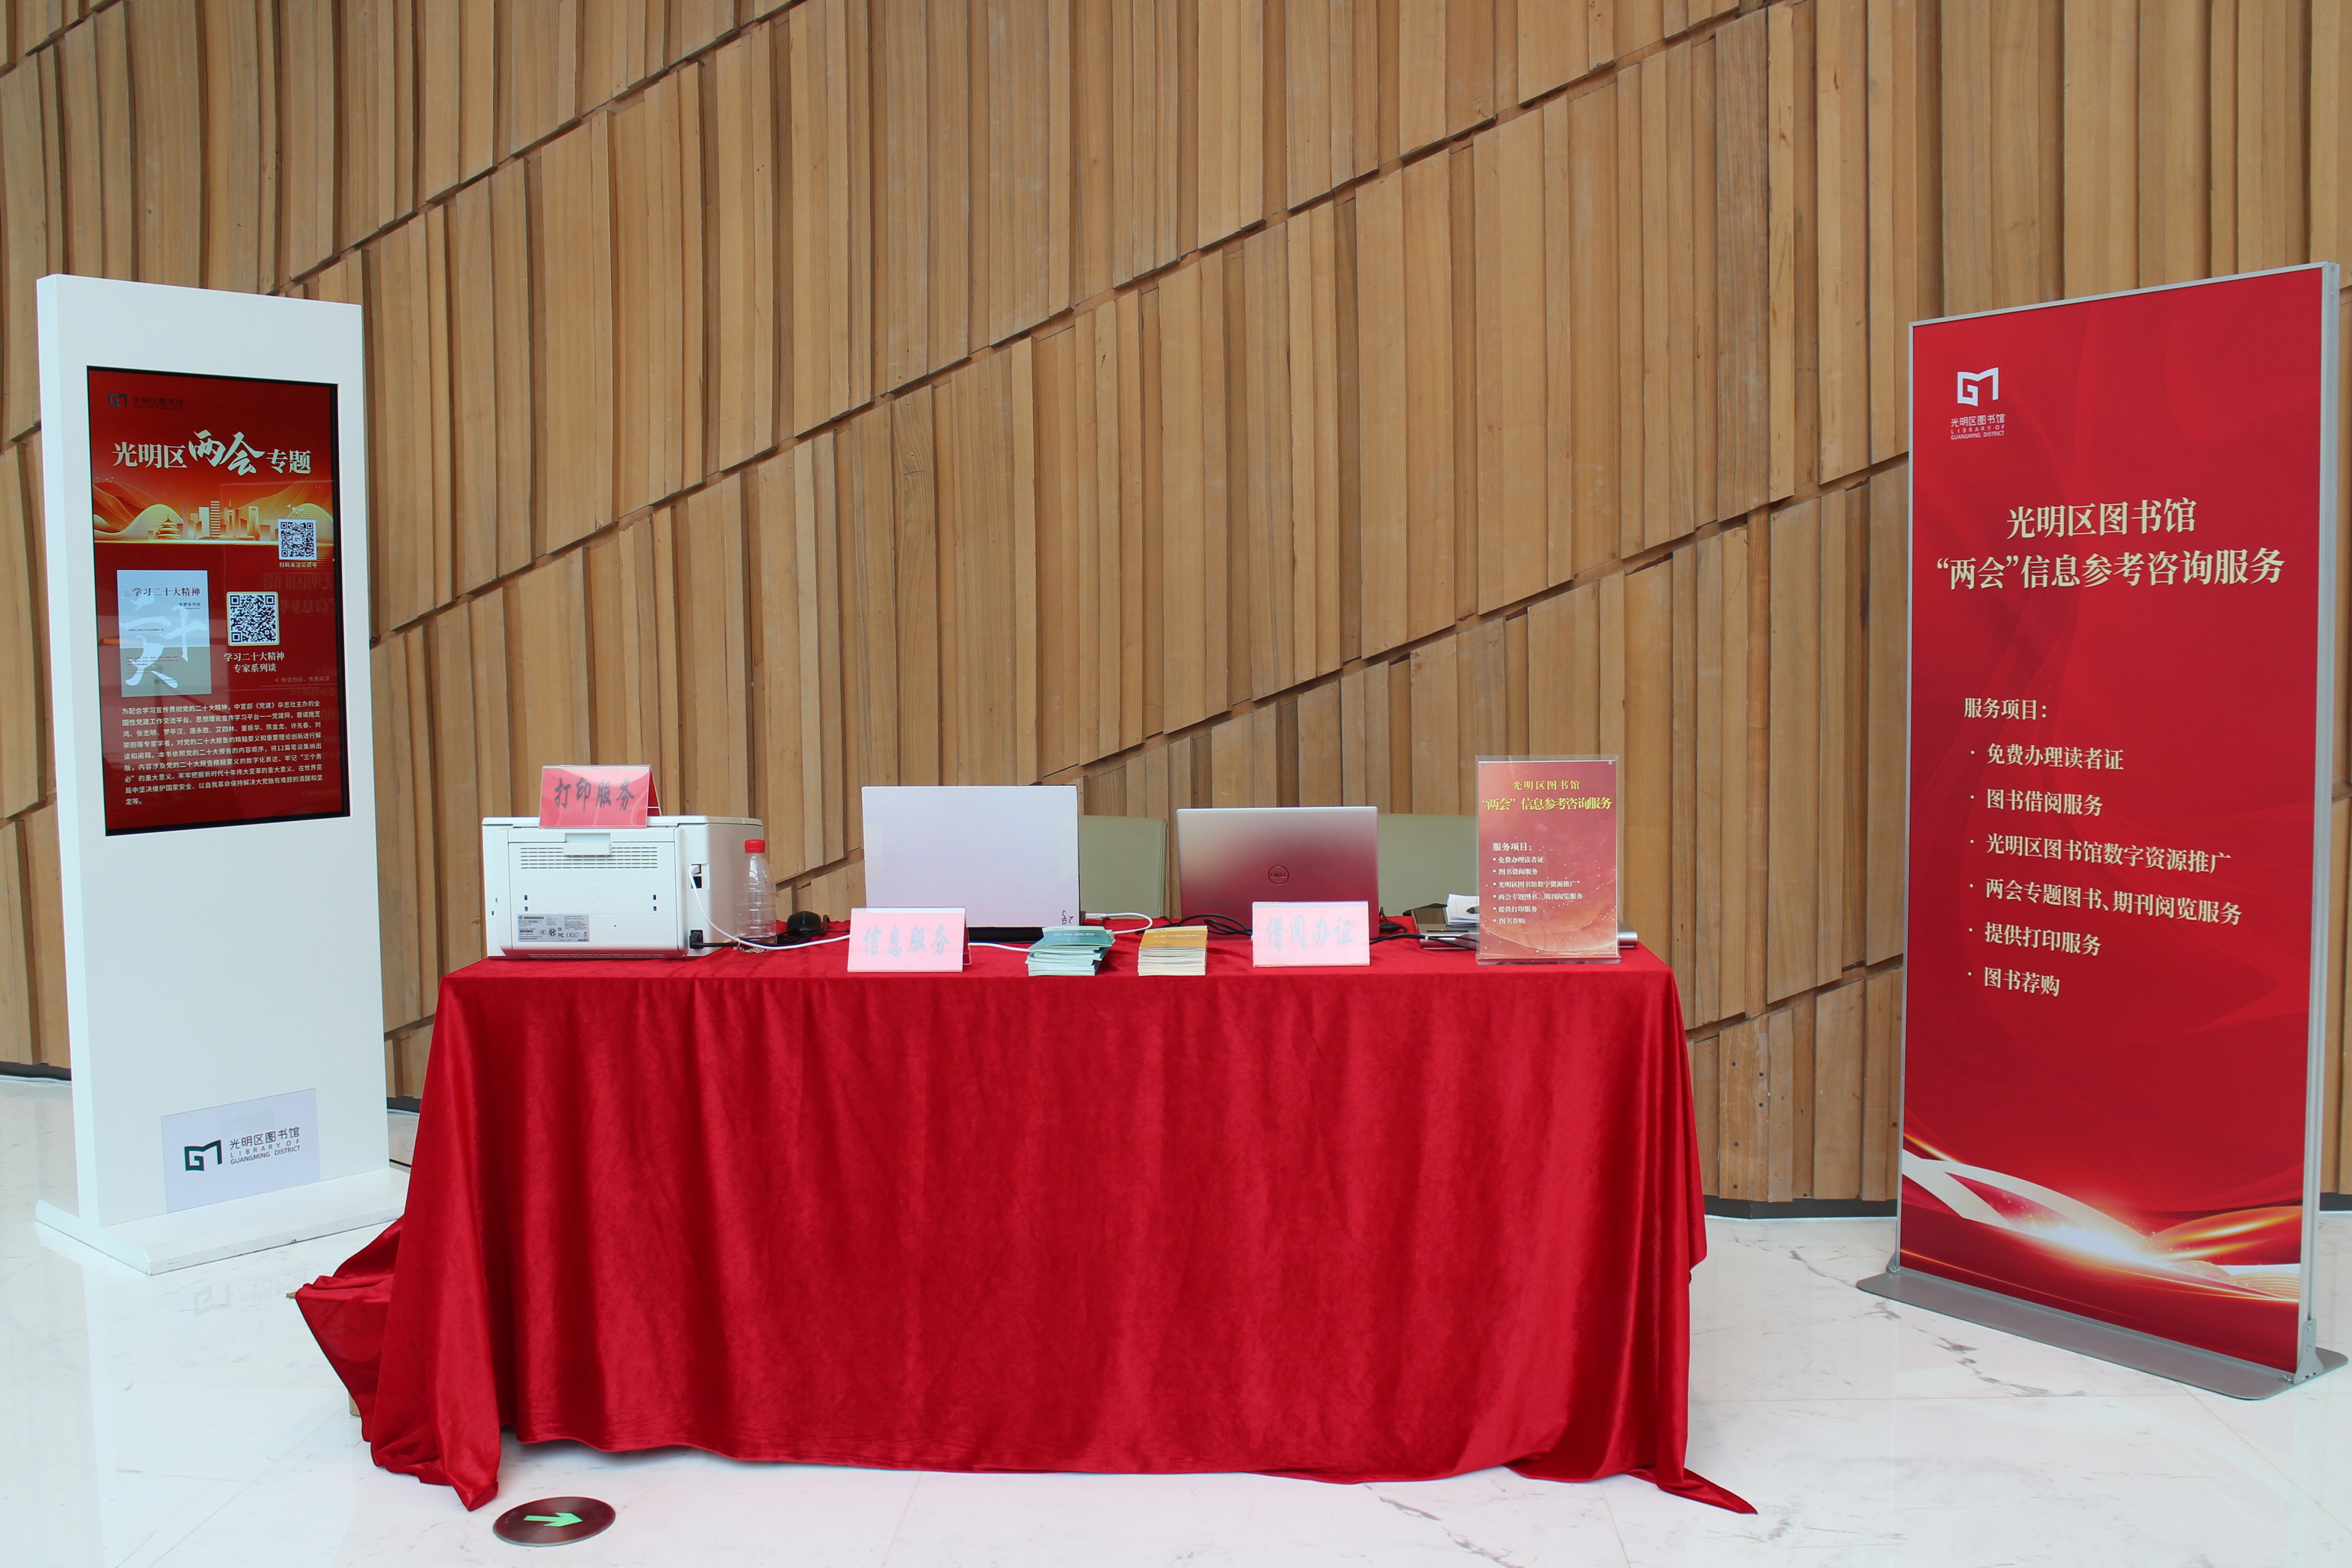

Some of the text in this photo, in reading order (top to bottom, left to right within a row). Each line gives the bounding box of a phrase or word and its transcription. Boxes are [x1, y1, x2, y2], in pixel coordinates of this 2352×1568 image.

[1951, 414, 2005, 428] 光明区图书馆
[1951, 426, 1991, 434] LIBRARY
[1951, 432, 1981, 441] GUANGMING
[2006, 497, 2198, 540] 光明区图书馆
[132, 587, 200, 597] 学习二十大精神
[223, 652, 285, 662] 学习二十大精神
[233, 663, 277, 673] 专家系列谈
[1987, 742, 2125, 770] 免费办理读者证
[1513, 780, 1581, 791] 光明区图书馆
[553, 777, 635, 814] 打印服务
[1986, 788, 2103, 817] 图书借阅服务
[1986, 833, 2232, 874] 光明区图书馆数字资源推广
[1499, 867, 1539, 876] 图书借阅服务
[1498, 880, 1576, 888] 光明区图书馆数字资源推广
[1498, 892, 1583, 901] 两会专题图书、期刊阅览服务
[1985, 877, 2243, 926] 两会专题图书、期刊阅览服务
[1498, 905, 1538, 913] 提供打印服务
[862, 923, 951, 957] 信息服务
[1984, 921, 2102, 956] 提供打印服务
[1984, 966, 2061, 997] 图书荐购
[229, 1127, 300, 1150] 光明区图书馆
[230, 1143, 281, 1158] LIBRARY
[230, 1145, 301, 1164] GUANGMING DISTRICT
